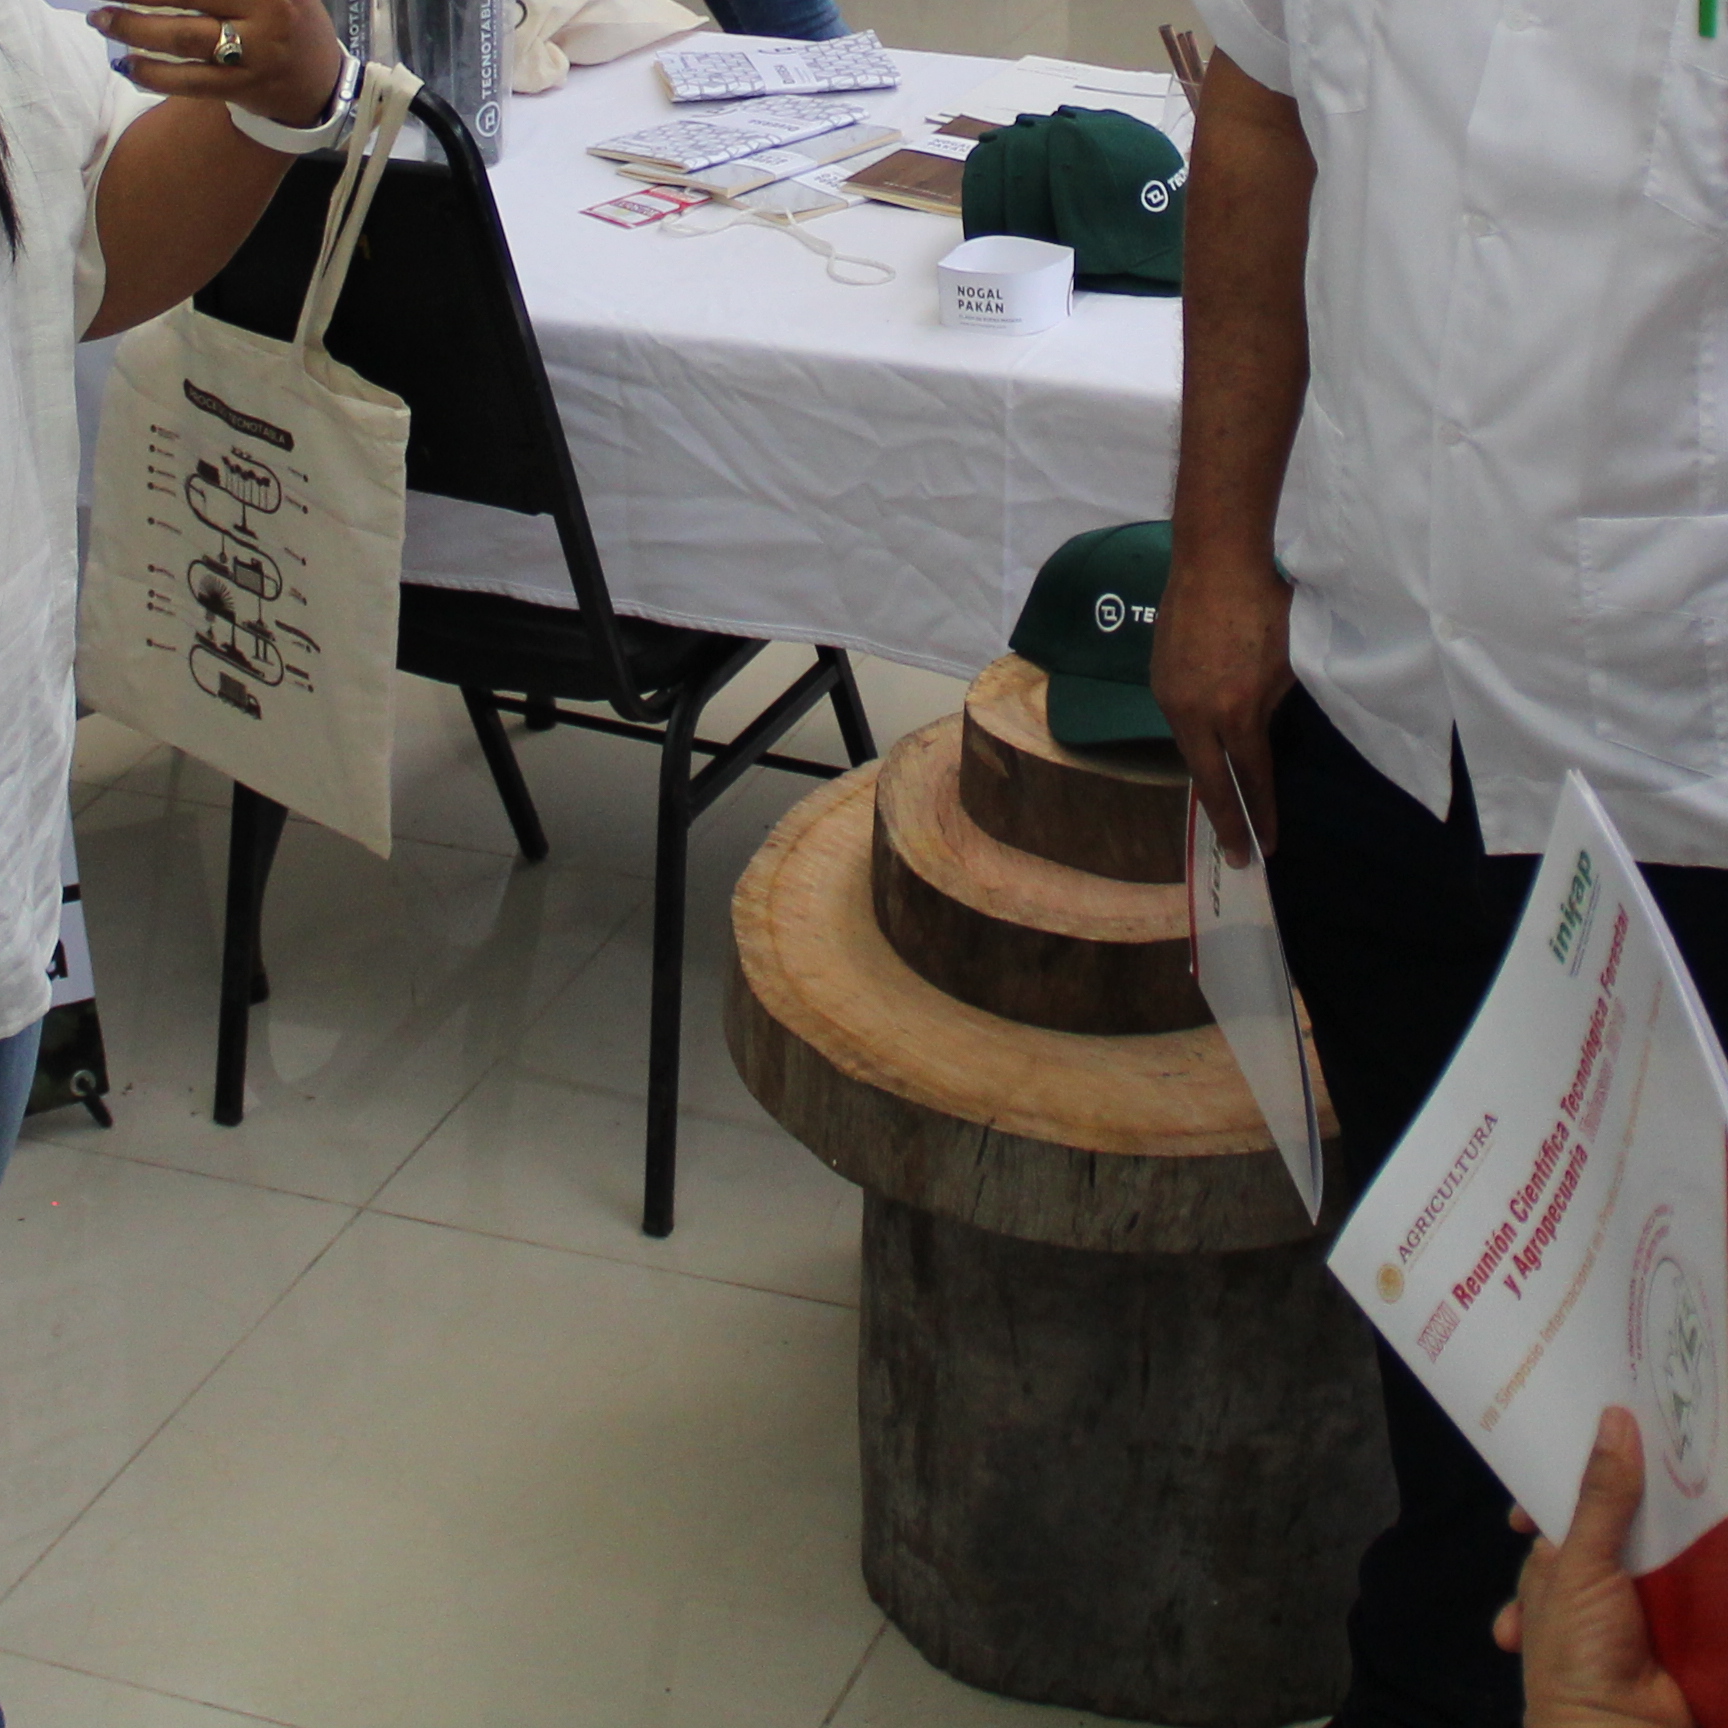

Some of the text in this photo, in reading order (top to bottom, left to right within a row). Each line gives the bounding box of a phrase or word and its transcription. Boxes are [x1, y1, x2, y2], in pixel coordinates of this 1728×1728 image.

[957, 285, 1003, 300] NOGAL
[958, 299, 1004, 314] PAKÁN
[1131, 605, 1159, 623] TE
[1549, 849, 1592, 965] inifap
[1452, 1223, 1518, 1311] Reunión
[1509, 1121, 1570, 1223] Científica
[1560, 997, 1609, 1121] Tecnológica
[1600, 903, 1630, 999] Forestal
[1397, 1114, 1498, 1264] AGRICULTURA
[1512, 1143, 1588, 1280] Agropecuaria
[1504, 1274, 1522, 1301] y
[1495, 1343, 1545, 1410] Simposio
